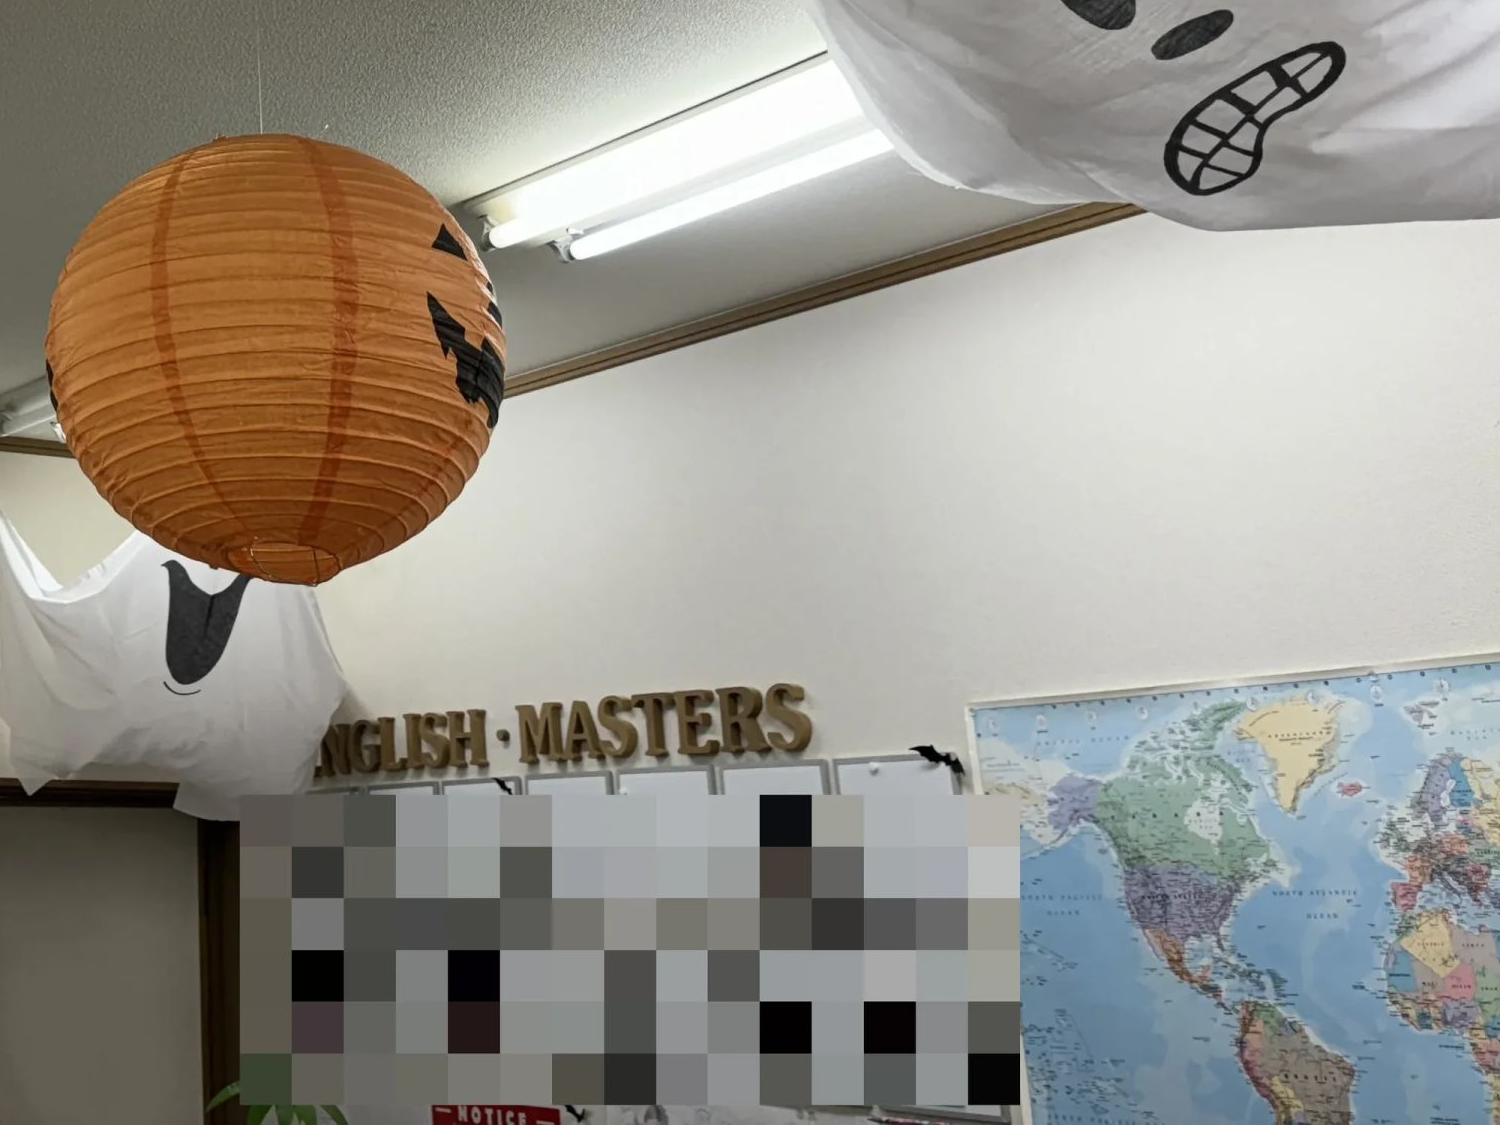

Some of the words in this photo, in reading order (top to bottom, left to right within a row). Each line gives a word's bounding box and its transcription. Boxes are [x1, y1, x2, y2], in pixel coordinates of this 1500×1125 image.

[314, 708, 490, 779] NGLISH
[515, 683, 813, 765] MASTERS
[457, 1105, 527, 1125] NOTICE
